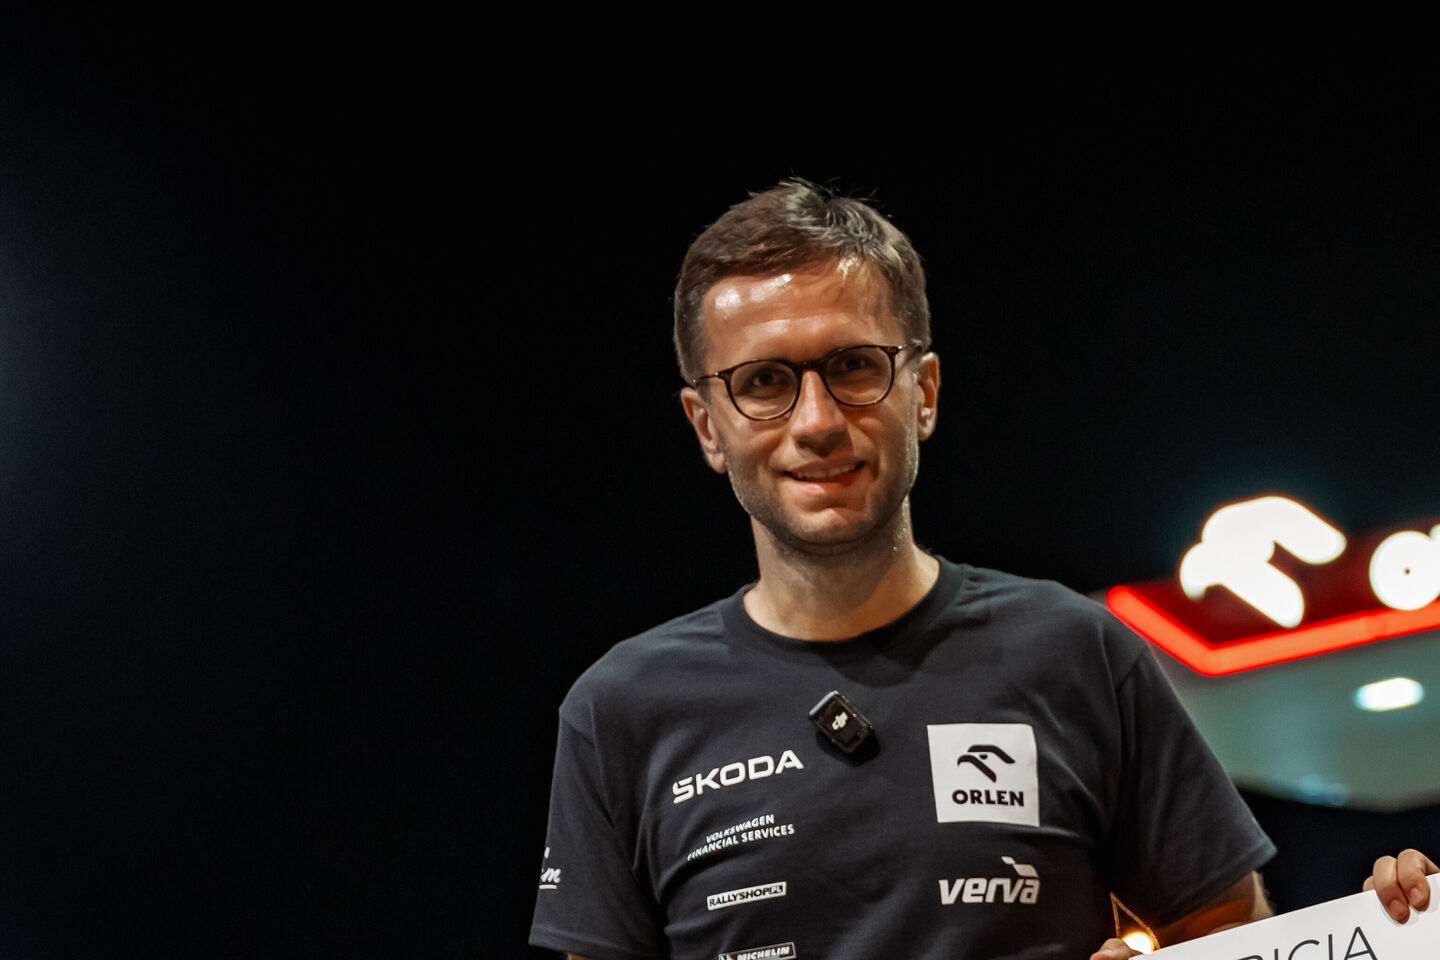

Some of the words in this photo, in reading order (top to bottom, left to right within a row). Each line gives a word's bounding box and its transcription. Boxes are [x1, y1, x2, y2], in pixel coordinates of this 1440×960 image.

[952, 789, 1024, 807] ORLEN
[687, 836, 740, 861] FINANCIAL
[741, 824, 795, 843] SERVICES
[706, 814, 775, 843] VOLKSWAGEN
[938, 877, 1041, 905] verva
